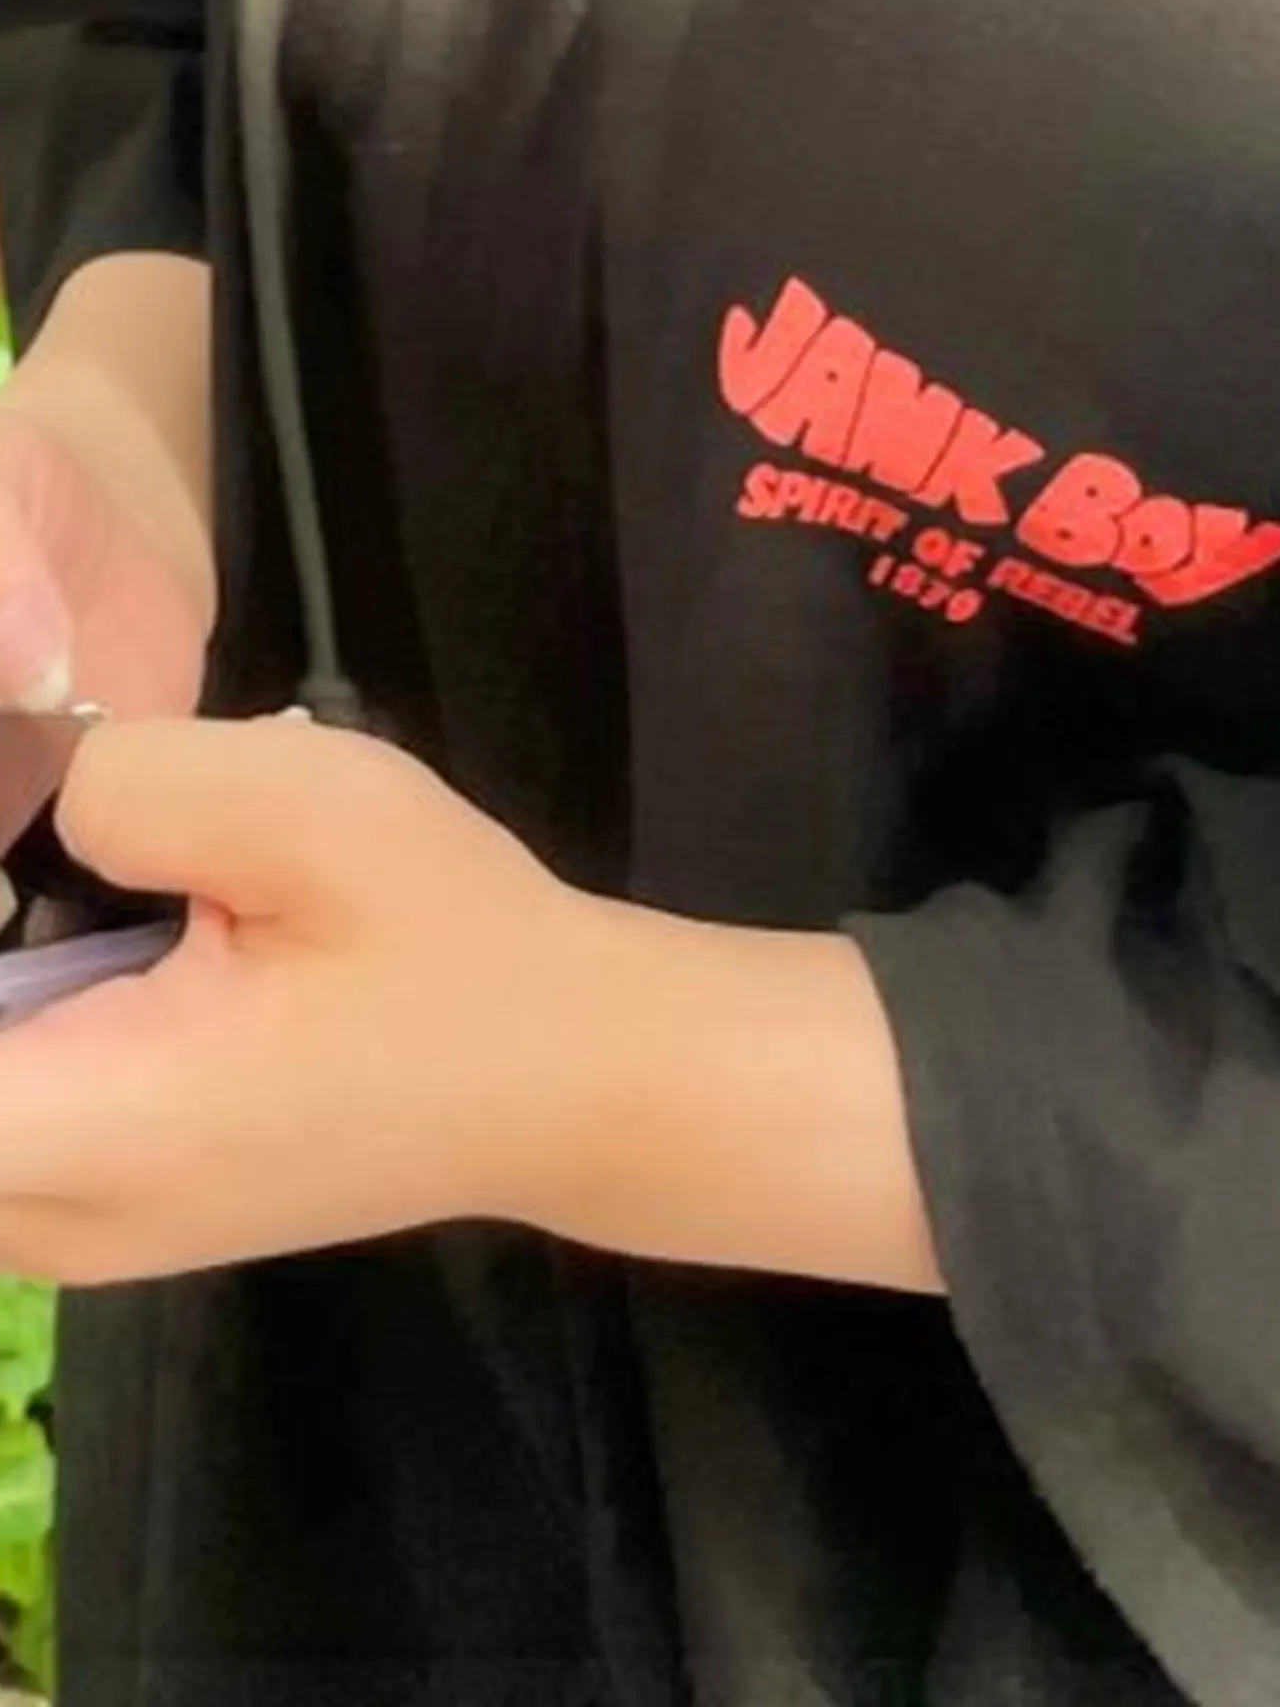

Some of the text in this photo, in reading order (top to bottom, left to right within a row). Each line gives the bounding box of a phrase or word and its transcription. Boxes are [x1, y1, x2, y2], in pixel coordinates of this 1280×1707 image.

[737, 462, 1140, 644] SPIRIT OF REBEL
